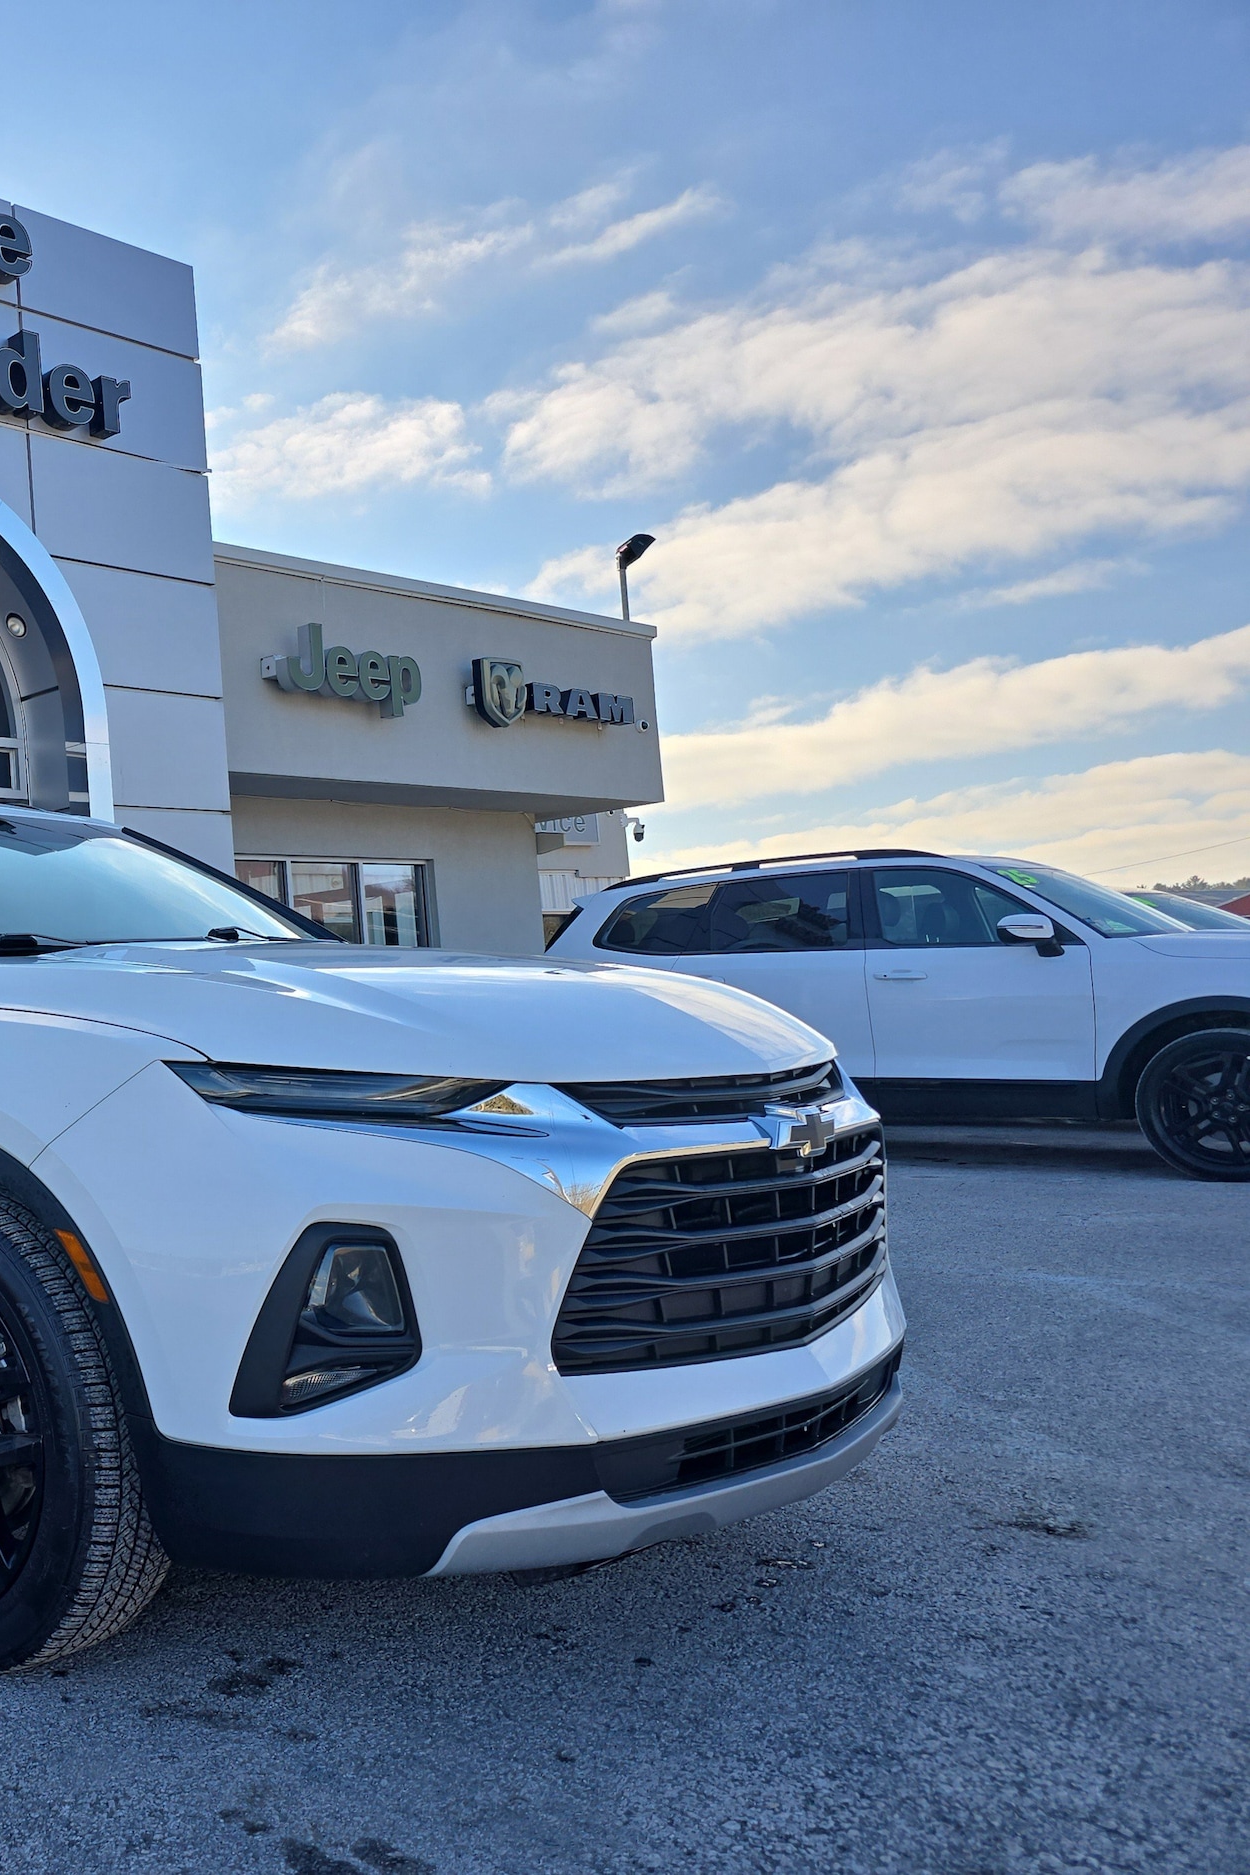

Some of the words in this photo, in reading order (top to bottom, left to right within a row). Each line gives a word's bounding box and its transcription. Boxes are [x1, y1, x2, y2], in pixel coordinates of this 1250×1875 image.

[276, 623, 421, 718] Jeep
[525, 682, 634, 726] RAM
[15, 1302, 67, 1409] ALTIMAX
